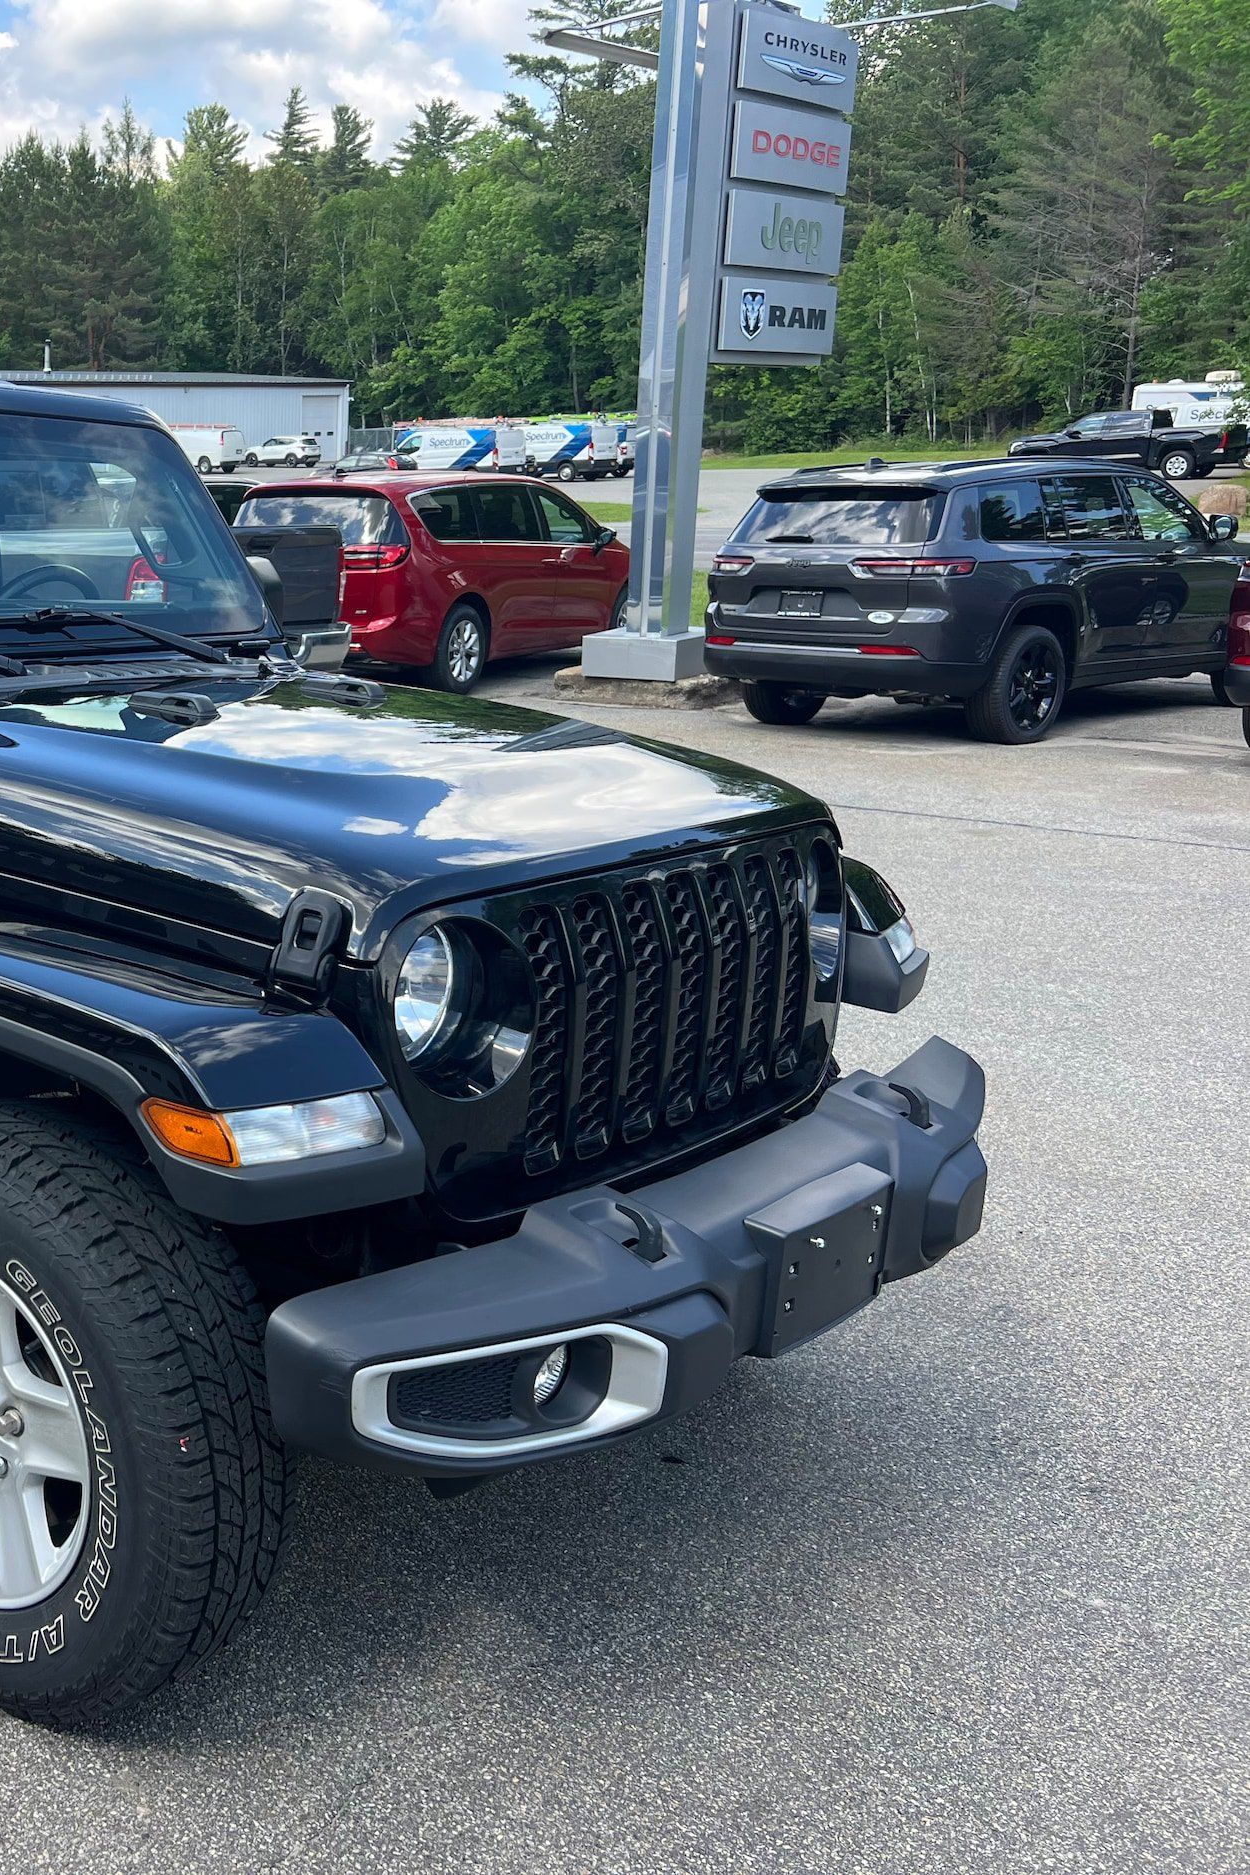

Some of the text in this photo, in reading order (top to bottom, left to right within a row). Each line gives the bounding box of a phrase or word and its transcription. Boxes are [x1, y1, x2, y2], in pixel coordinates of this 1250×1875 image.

[764, 31, 847, 67] CHRYSLER
[752, 130, 840, 168] DODGE
[760, 202, 822, 264] Jeep
[768, 304, 827, 331] RAM
[429, 437, 467, 448] Spectrum
[526, 431, 563, 442] Spectrum
[5, 1259, 119, 1623] GEOLANDAR
